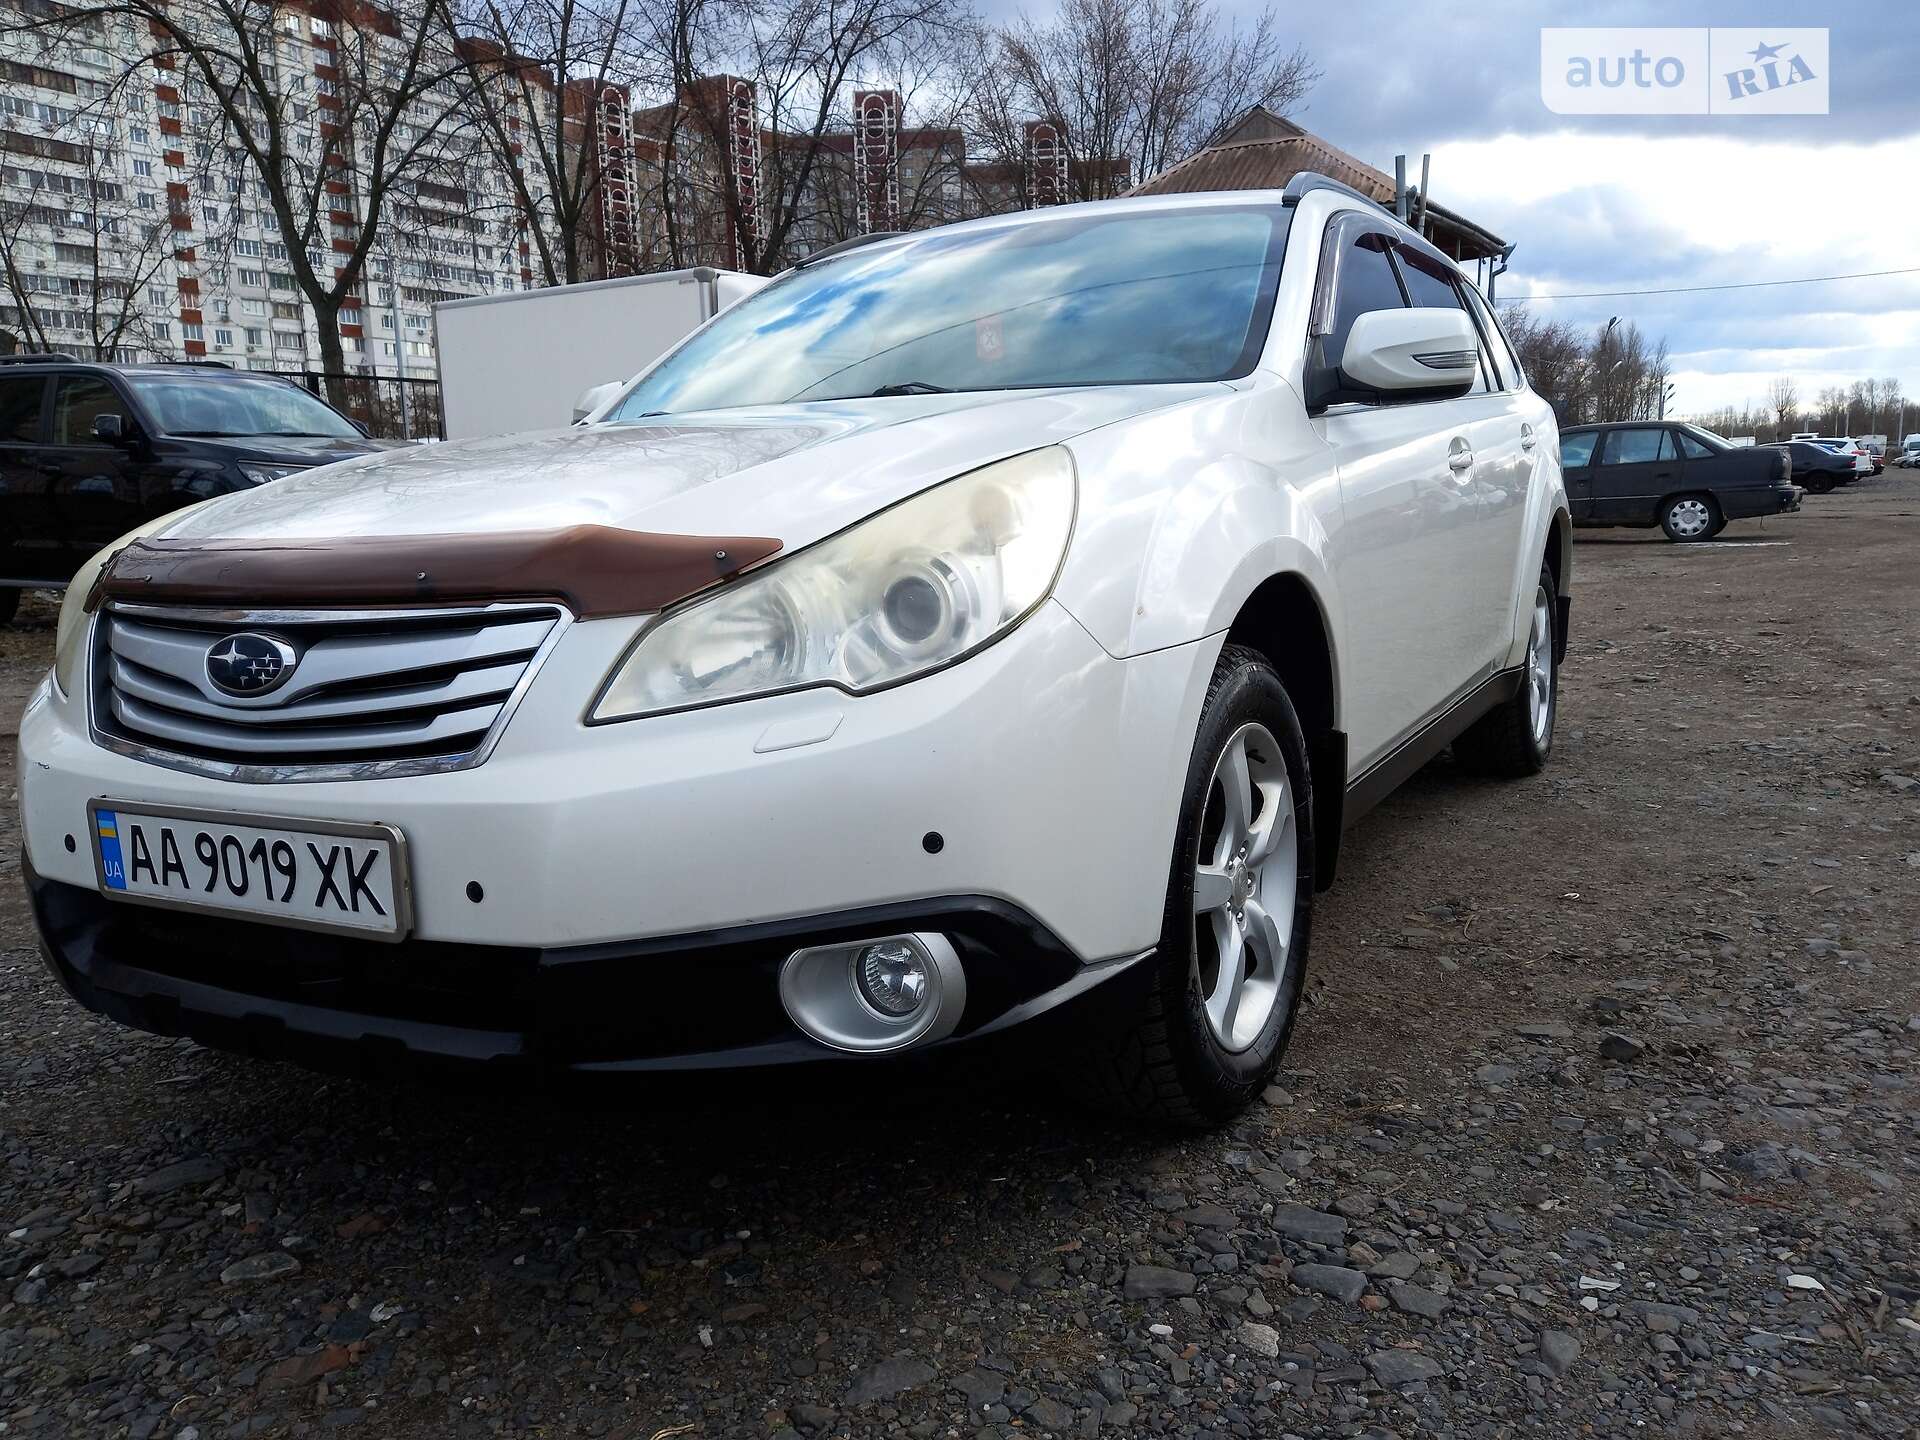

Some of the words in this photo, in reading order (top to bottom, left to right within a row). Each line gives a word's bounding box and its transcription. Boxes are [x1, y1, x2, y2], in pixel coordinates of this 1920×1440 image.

[103, 859, 123, 879] UA
[130, 824, 190, 889] AA
[194, 832, 297, 903] 9019
[306, 842, 387, 915] XK
